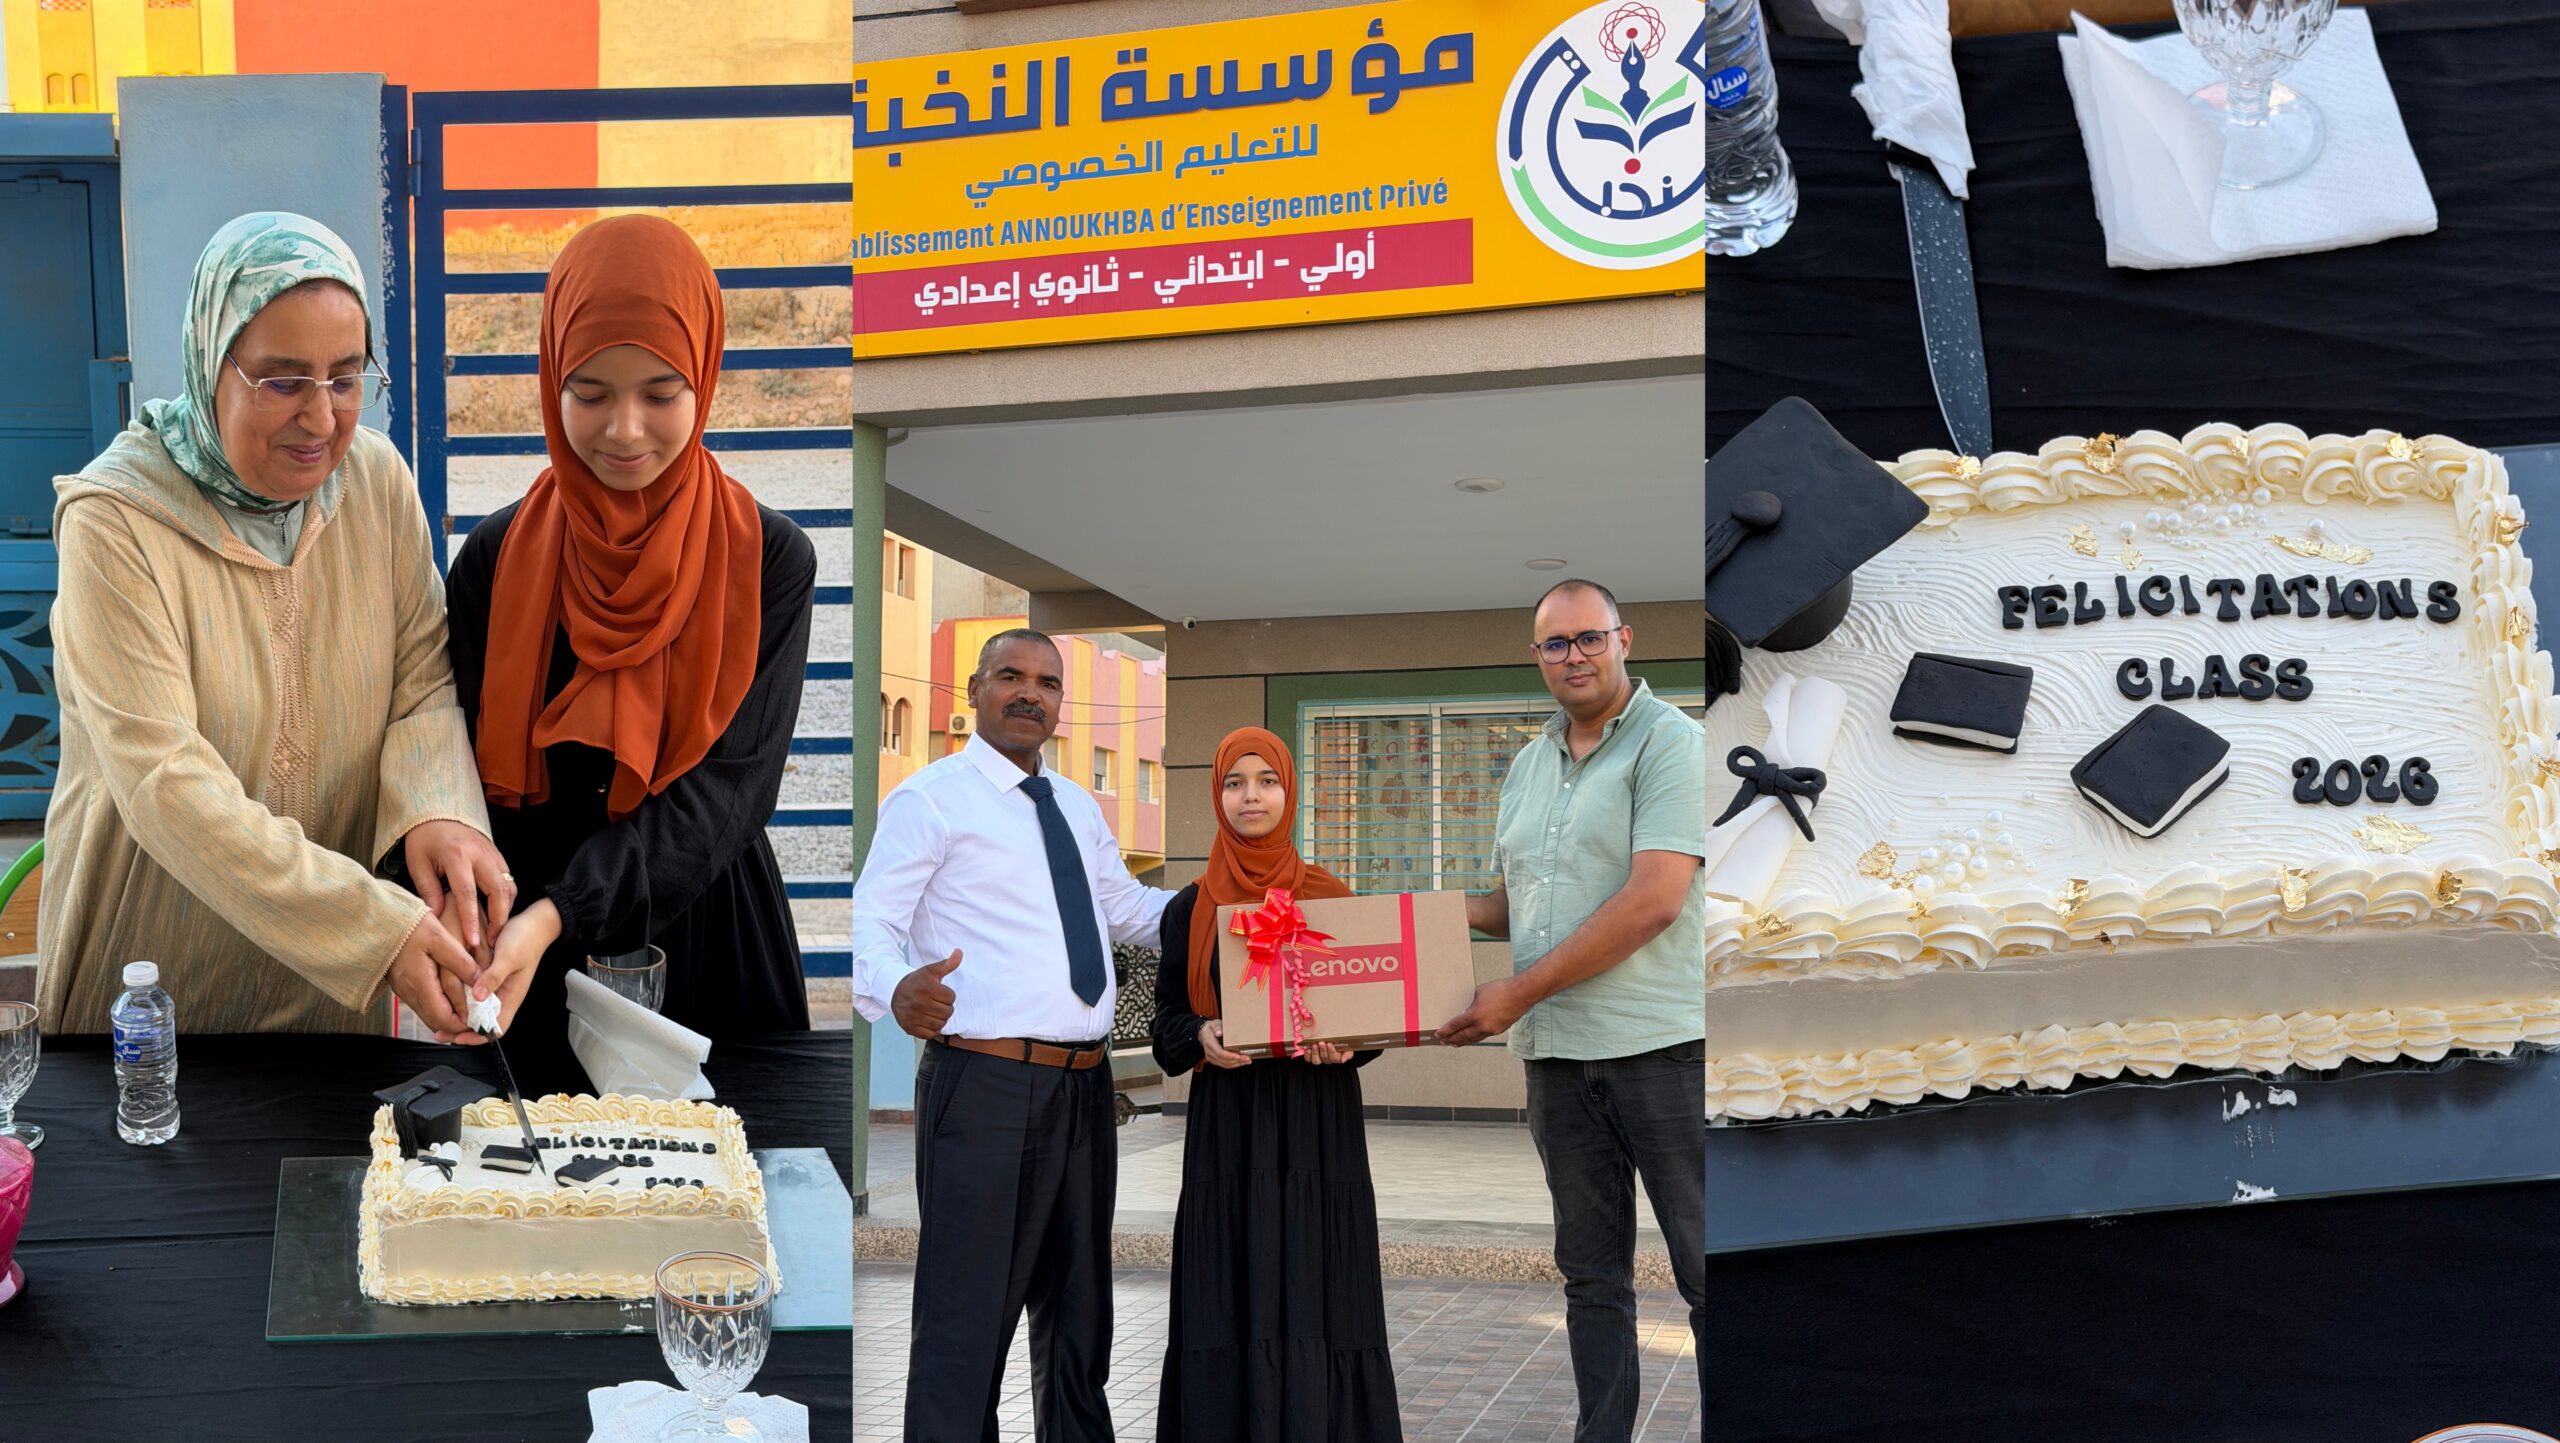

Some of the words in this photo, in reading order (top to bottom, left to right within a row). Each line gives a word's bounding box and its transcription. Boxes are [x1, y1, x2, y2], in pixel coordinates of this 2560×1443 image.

[1101, 18, 1474, 122] مؤسسة
[965, 139, 1163, 209] الخصوصي
[1175, 123, 1318, 179] للتعليم
[999, 207, 1155, 246] ANNOUKHBA
[1161, 185, 1373, 231] d'Enseignement
[1379, 177, 1448, 211] Privé
[1029, 256, 1119, 306] ثانوي
[1153, 249, 1264, 305] ابتدائي
[1299, 230, 1375, 292] أولي
[913, 271, 1020, 316] إعدادي
[2116, 653, 2314, 701] CLASS
[2291, 754, 2440, 807] 2026
[1295, 955, 1399, 978] enovo
